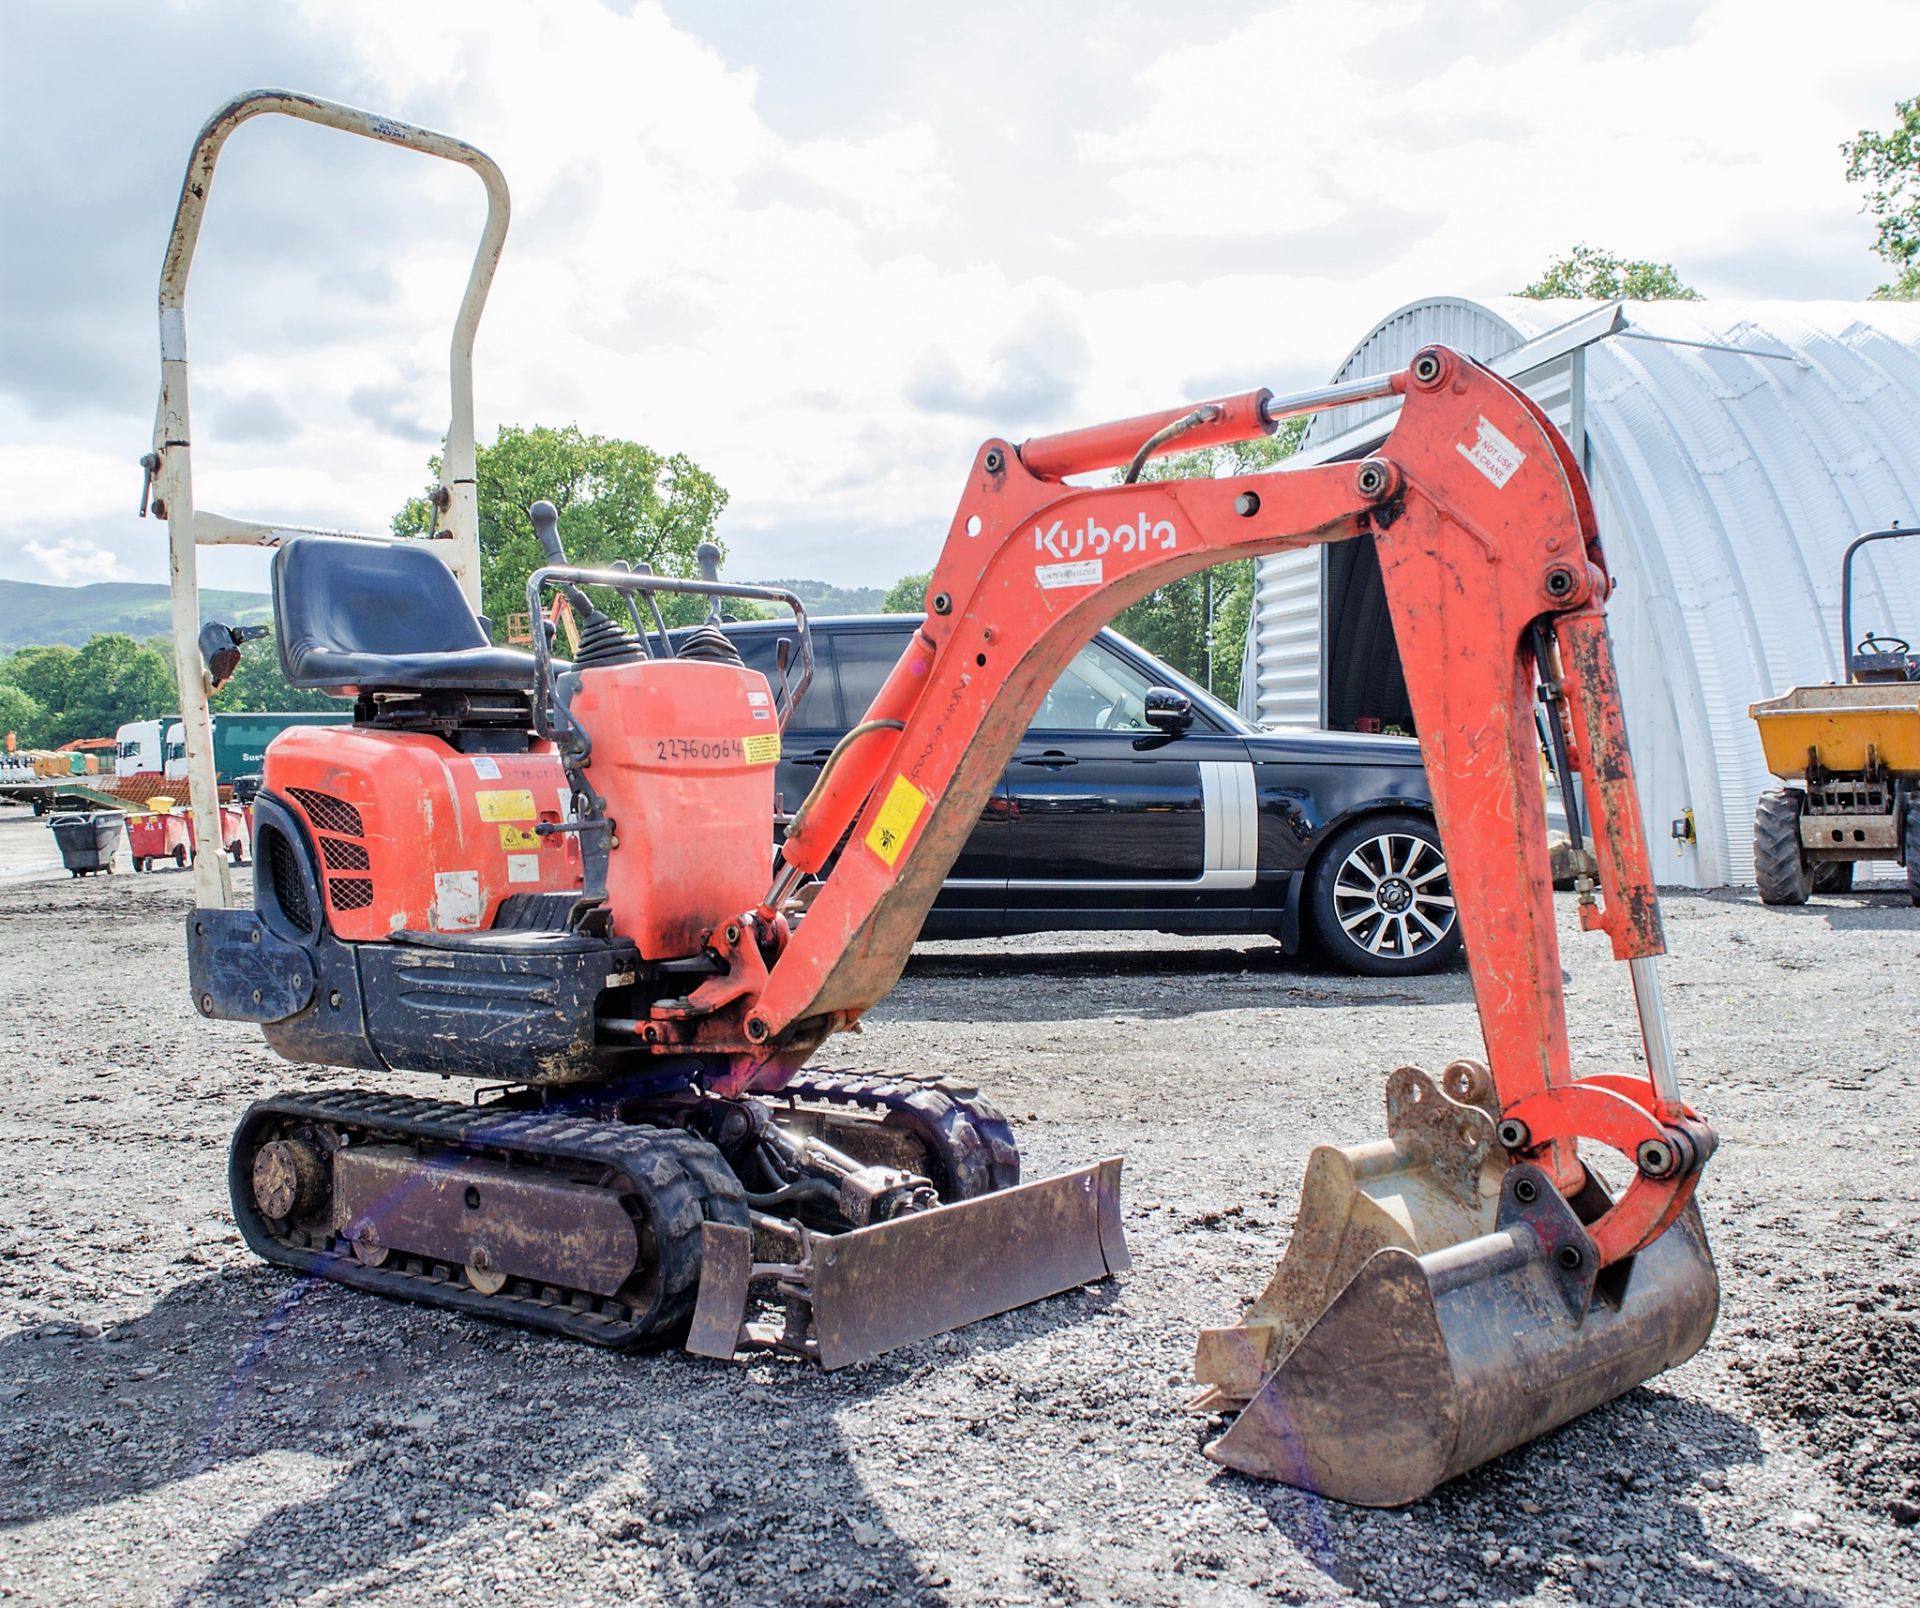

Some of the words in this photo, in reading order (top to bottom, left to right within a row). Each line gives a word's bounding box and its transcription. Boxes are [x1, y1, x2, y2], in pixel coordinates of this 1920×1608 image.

[1479, 455, 1505, 480] CRANE
[1481, 440, 1499, 456] NOT
[1497, 454, 1514, 471] USE
[1034, 511, 1177, 559] Kubota
[656, 738, 744, 761] 22760064
